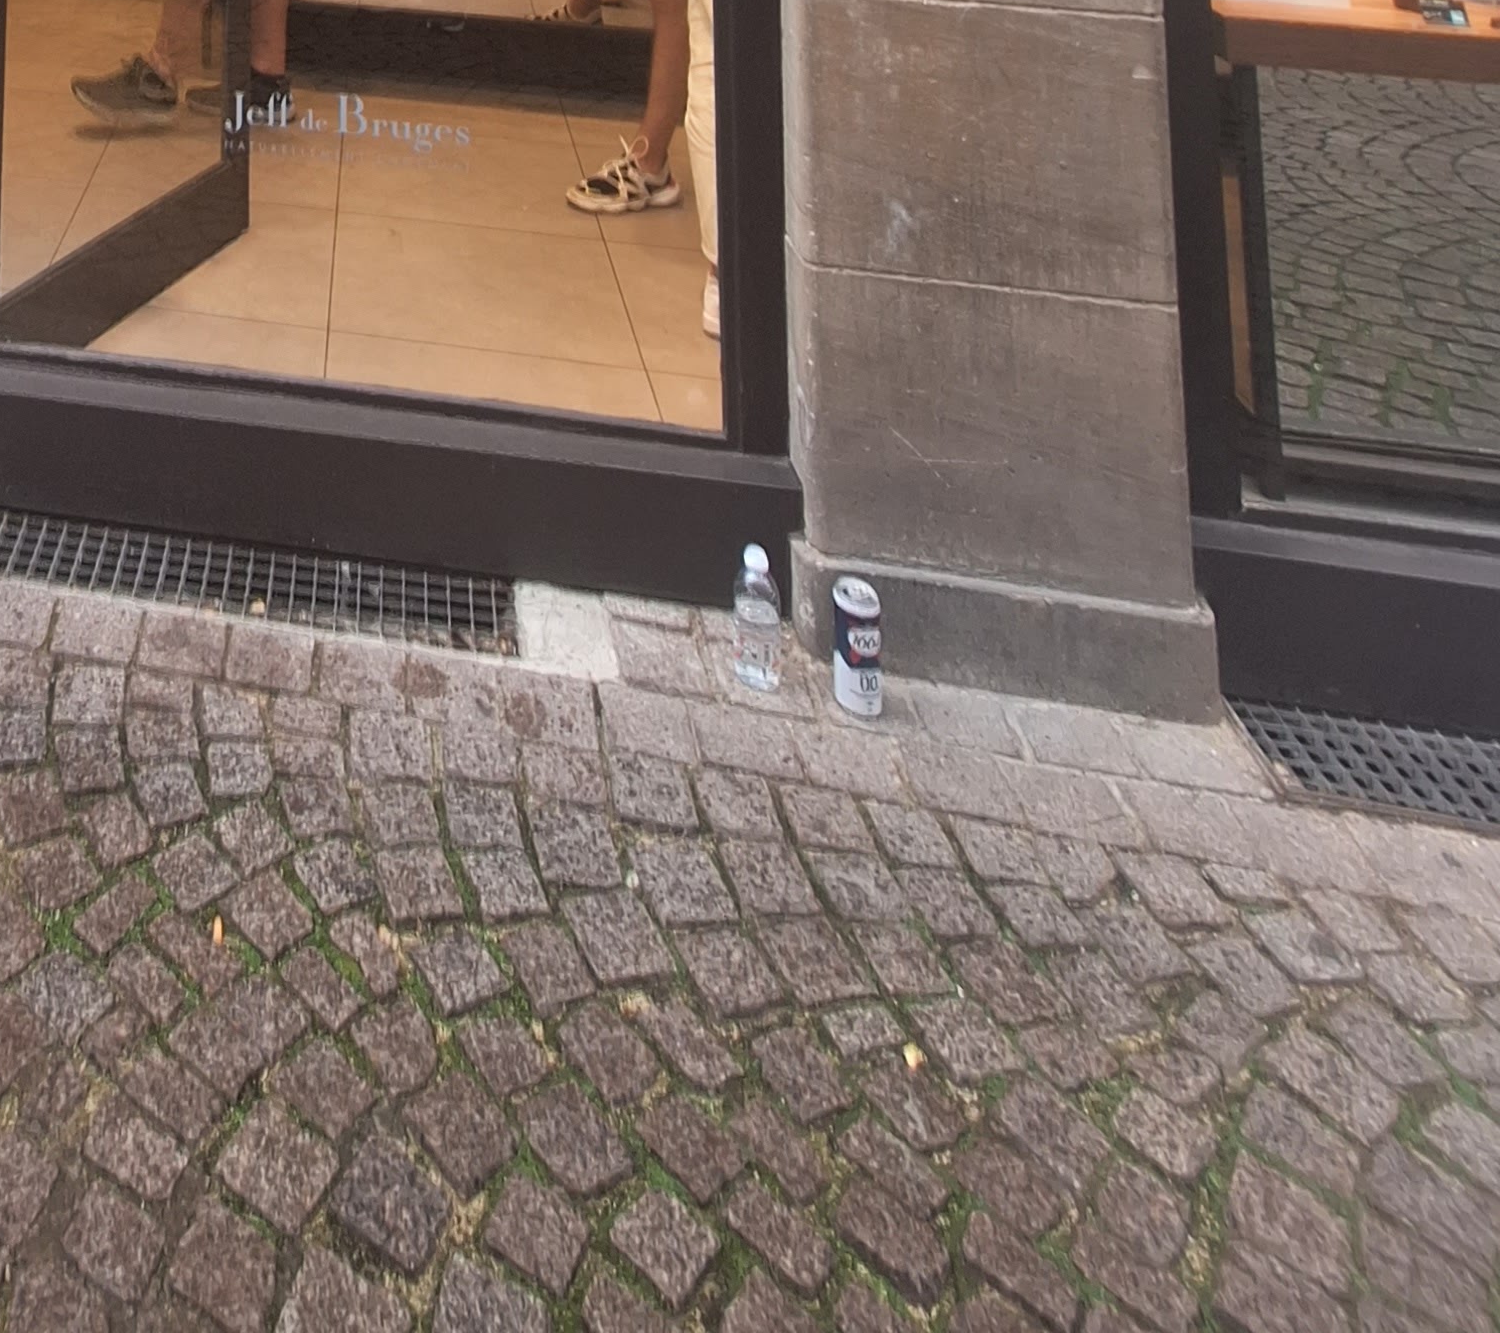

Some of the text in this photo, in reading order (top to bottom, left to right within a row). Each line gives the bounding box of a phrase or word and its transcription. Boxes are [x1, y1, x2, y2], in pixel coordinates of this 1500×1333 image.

[224, 89, 472, 155] Jeff de Bruges
